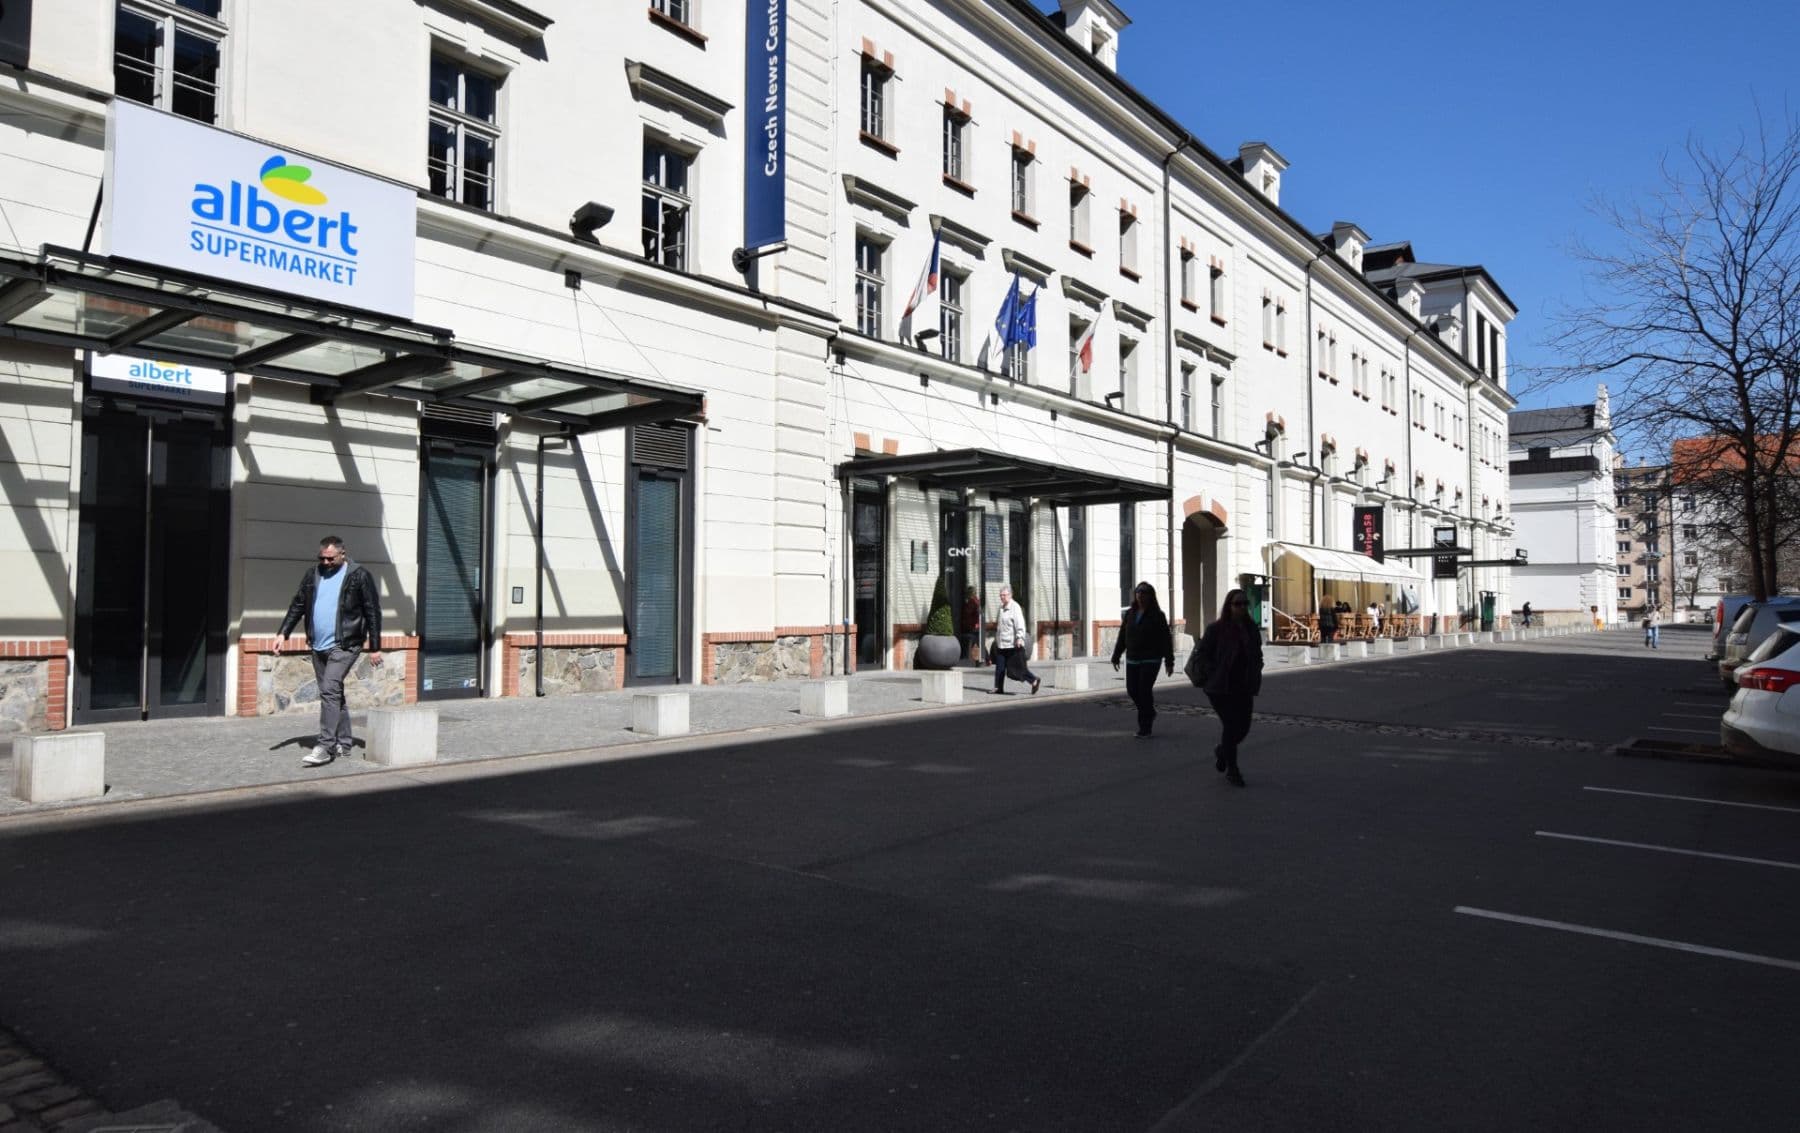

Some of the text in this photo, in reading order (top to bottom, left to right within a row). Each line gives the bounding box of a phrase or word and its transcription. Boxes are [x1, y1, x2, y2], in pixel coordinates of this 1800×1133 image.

[765, 55, 778, 113] News
[764, 116, 778, 177] Czech
[190, 180, 359, 257] albert
[190, 229, 358, 287] SUPERMARKET
[128, 362, 193, 385] albert
